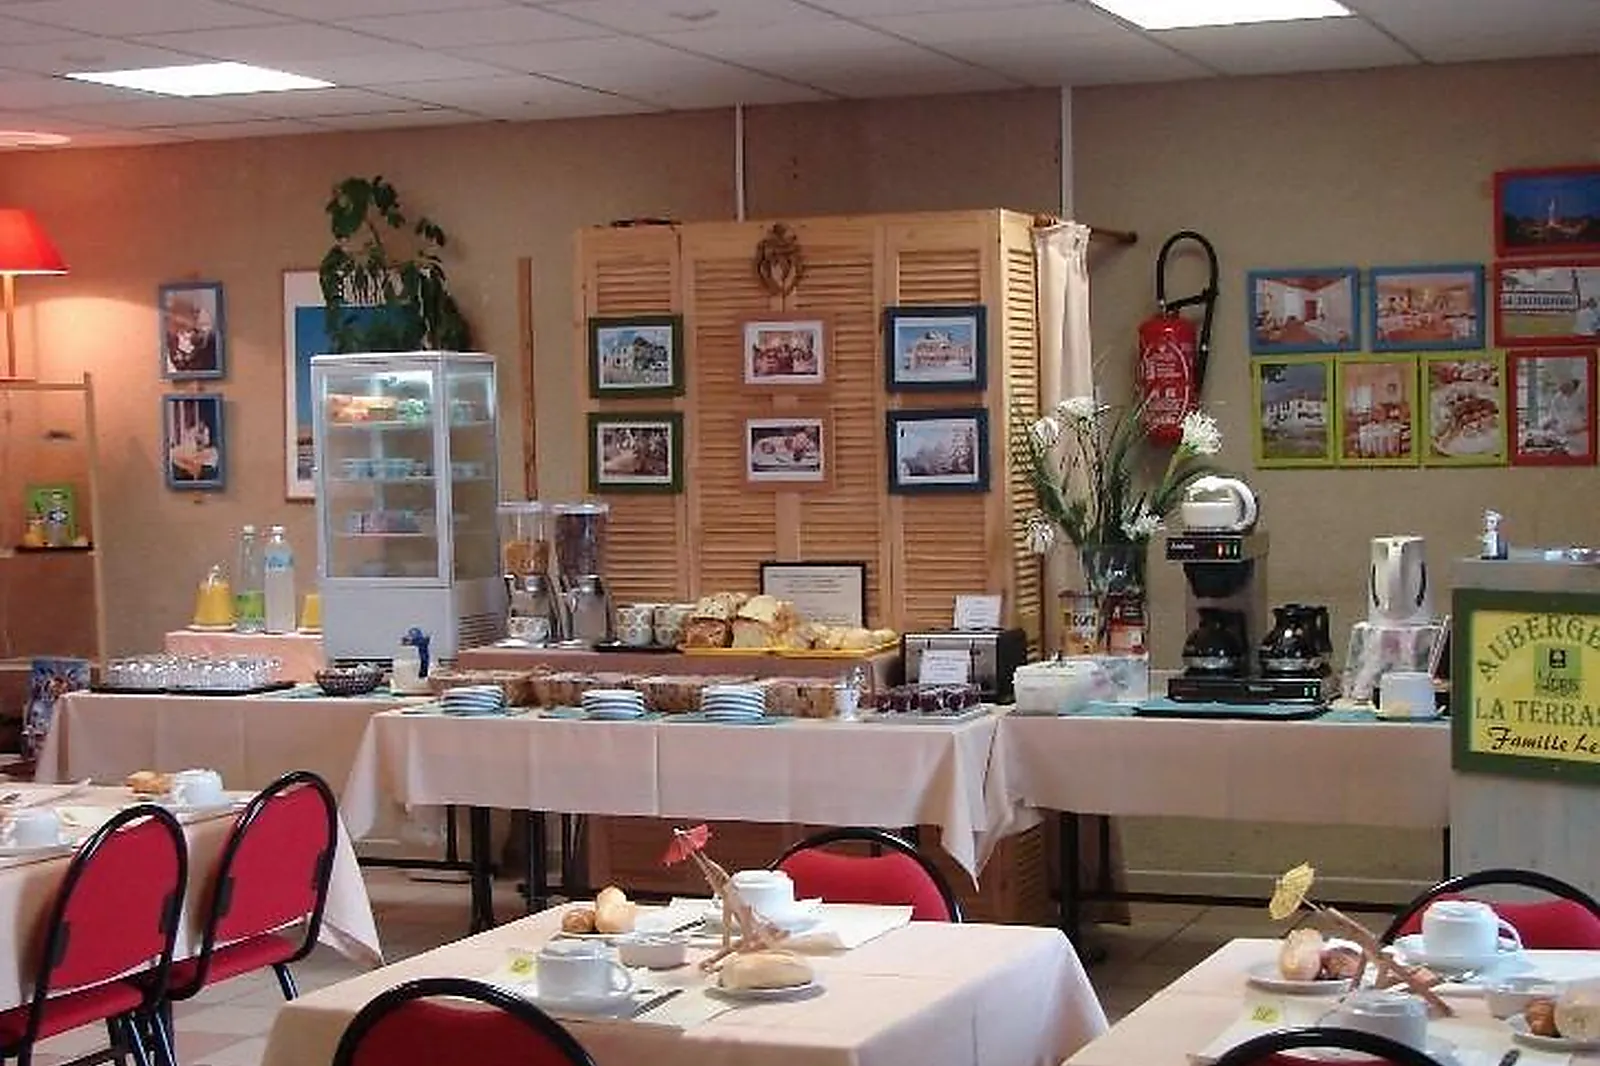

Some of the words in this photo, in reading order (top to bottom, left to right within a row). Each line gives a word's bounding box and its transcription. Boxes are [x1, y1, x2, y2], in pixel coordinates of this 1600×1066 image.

[1476, 611, 1600, 682] AUBERGE
[1475, 698, 1508, 720] LA
[1513, 700, 1600, 728] TERRA
[1487, 726, 1569, 751] Famille
